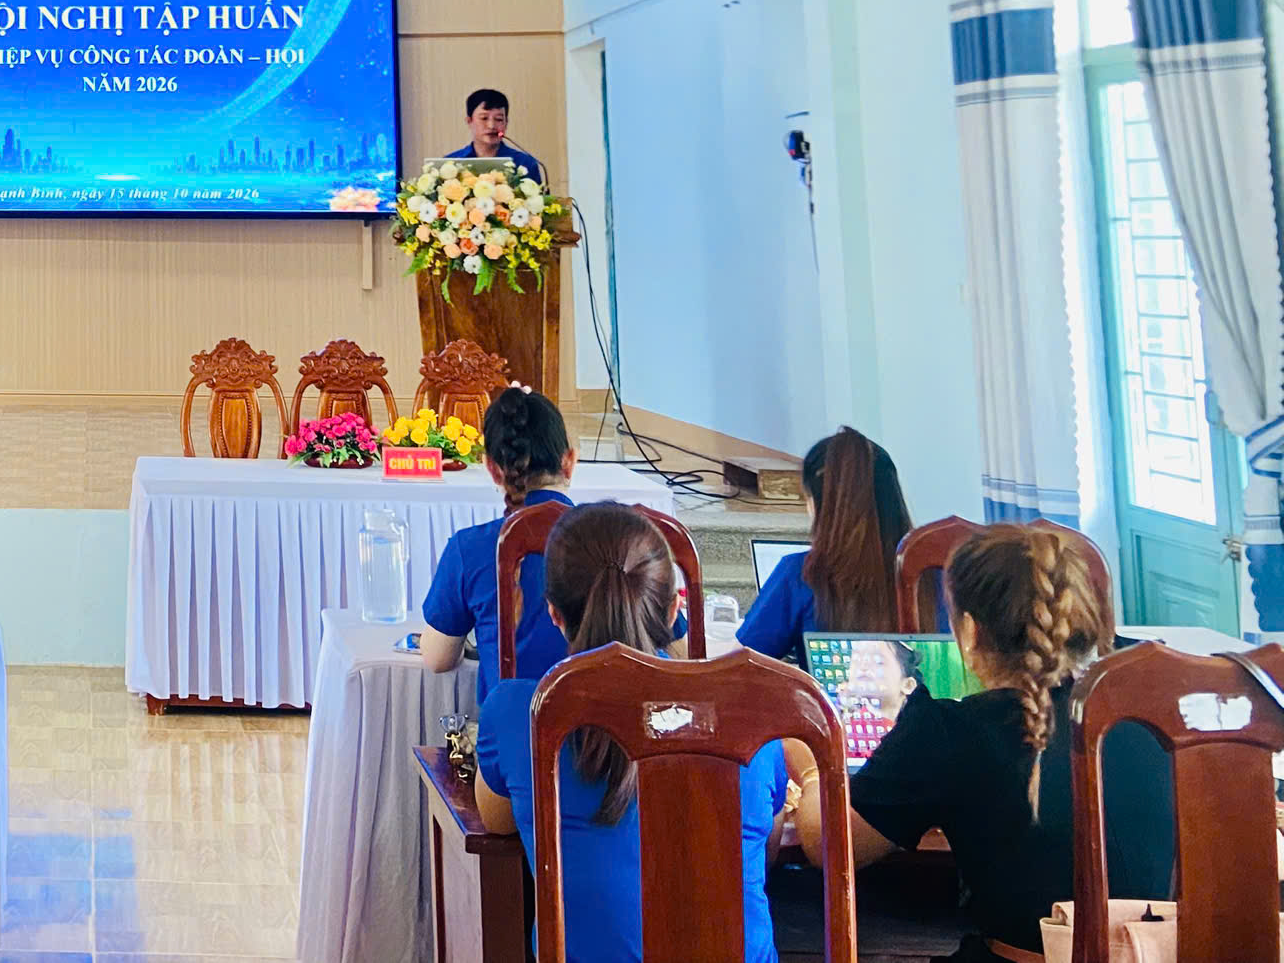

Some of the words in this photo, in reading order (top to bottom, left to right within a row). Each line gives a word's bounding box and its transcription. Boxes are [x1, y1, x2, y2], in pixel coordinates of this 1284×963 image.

[37, 5, 124, 37] NGHỊ
[133, 1, 200, 37] TẬP
[35, 49, 64, 69] VỤ
[69, 45, 131, 65] CÔNG
[135, 45, 179, 65] TÁC
[184, 45, 244, 65] ĐOÀN
[83, 72, 131, 92] NĂM
[136, 76, 178, 92] 2026
[227, 188, 260, 200] 2026
[389, 454, 414, 470] CHỦ
[416, 456, 437, 470] TRÌ
